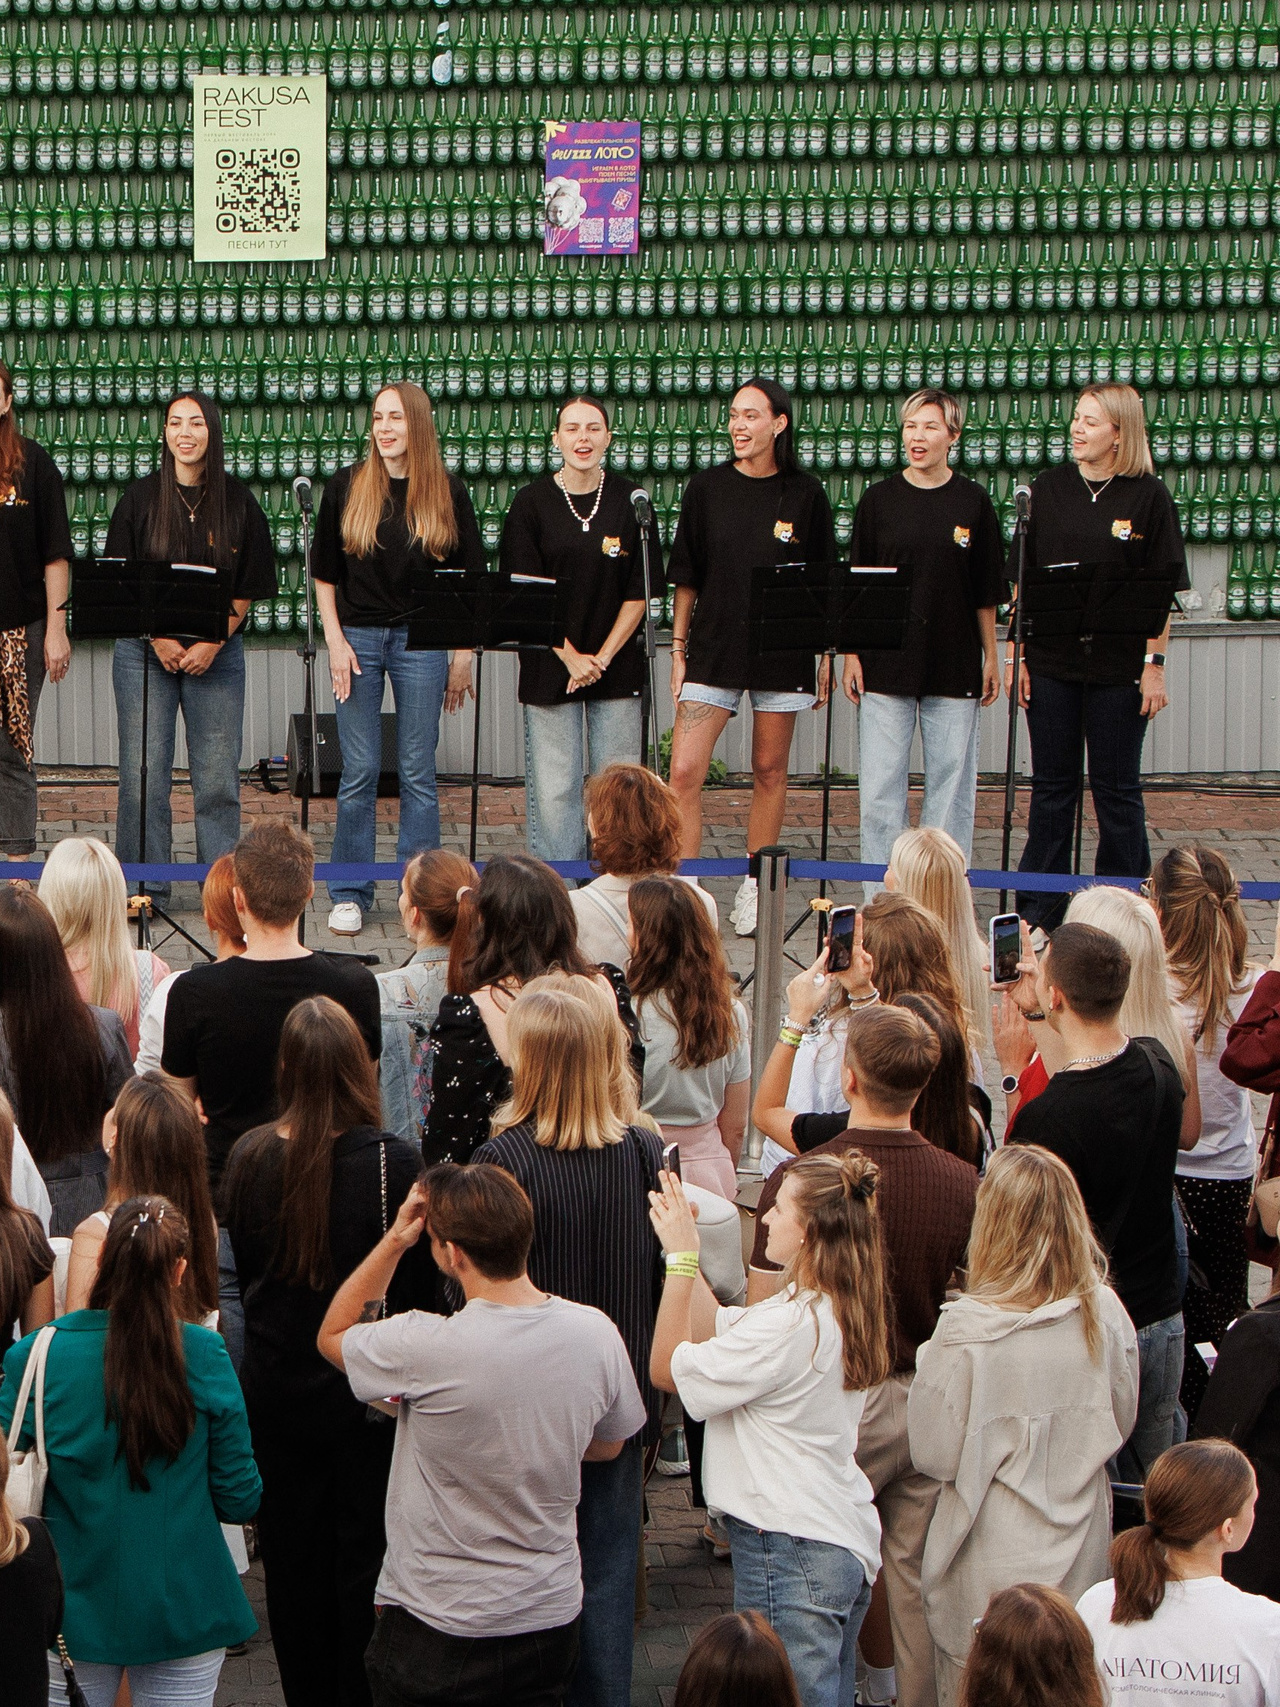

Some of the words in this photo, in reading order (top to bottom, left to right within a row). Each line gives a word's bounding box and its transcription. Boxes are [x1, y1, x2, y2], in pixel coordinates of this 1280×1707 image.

[203, 86, 311, 107] RAKUSA
[203, 109, 267, 128] FEST
[595, 146, 634, 159] ЛОТО
[227, 240, 265, 249] ПЕСНИ
[269, 239, 288, 249] ТУТ
[1190, 1690, 1227, 1699] КЛИНИКА
